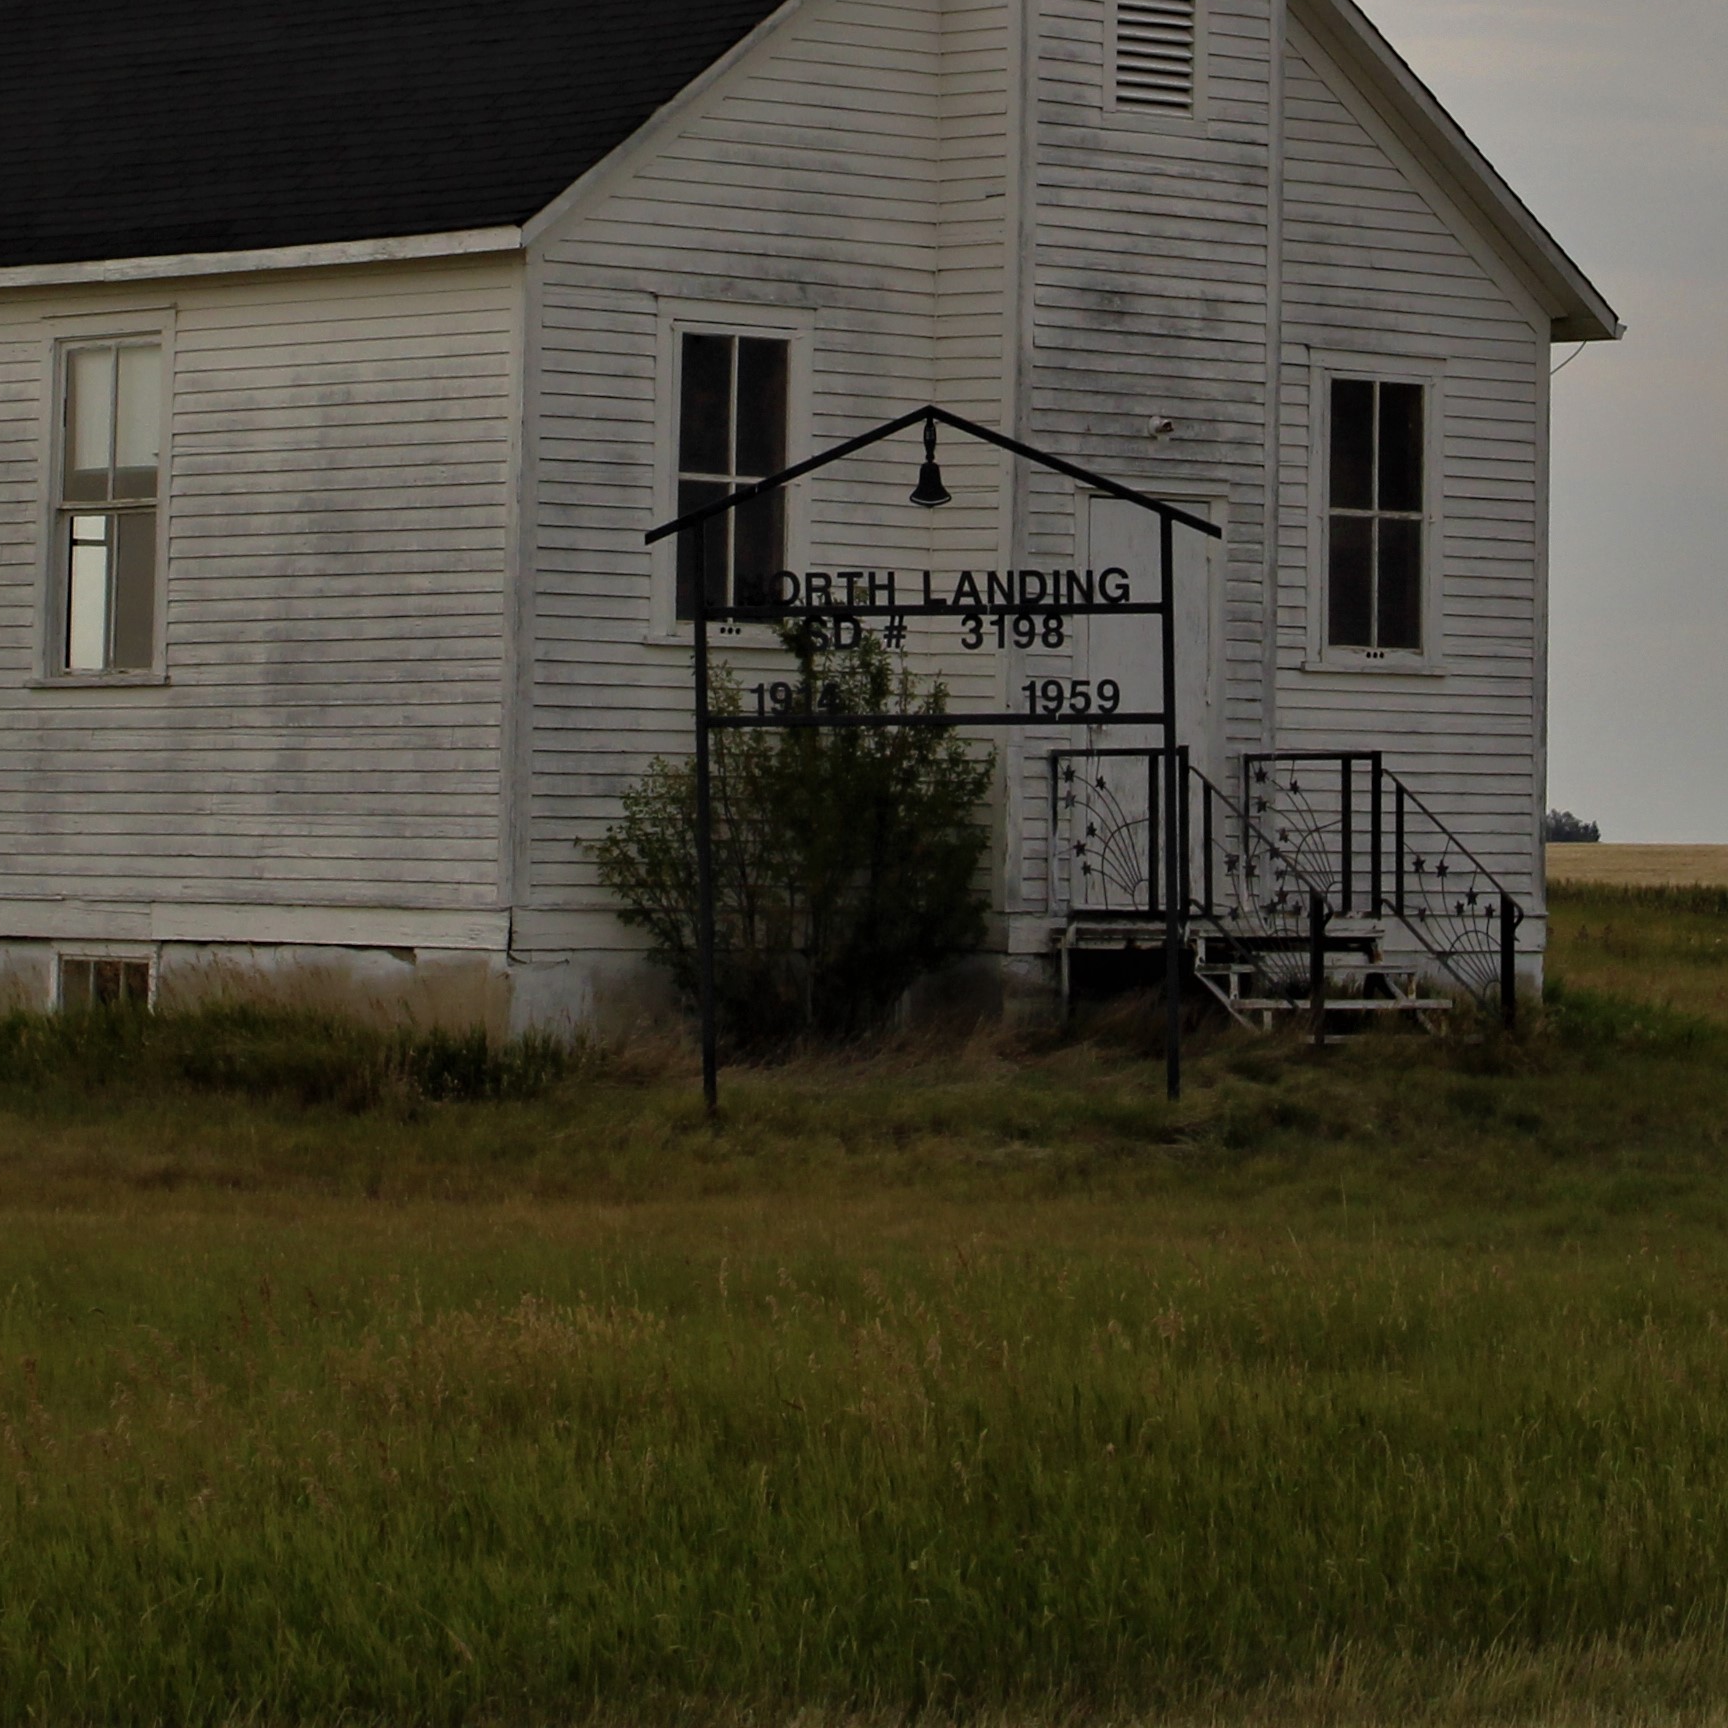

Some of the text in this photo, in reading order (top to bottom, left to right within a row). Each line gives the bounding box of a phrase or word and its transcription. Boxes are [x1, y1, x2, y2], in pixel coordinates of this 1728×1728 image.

[738, 567, 1131, 606] ORTH LANDING
[804, 615, 1064, 650] SD # 3198
[750, 679, 1121, 716] 1914 1959
